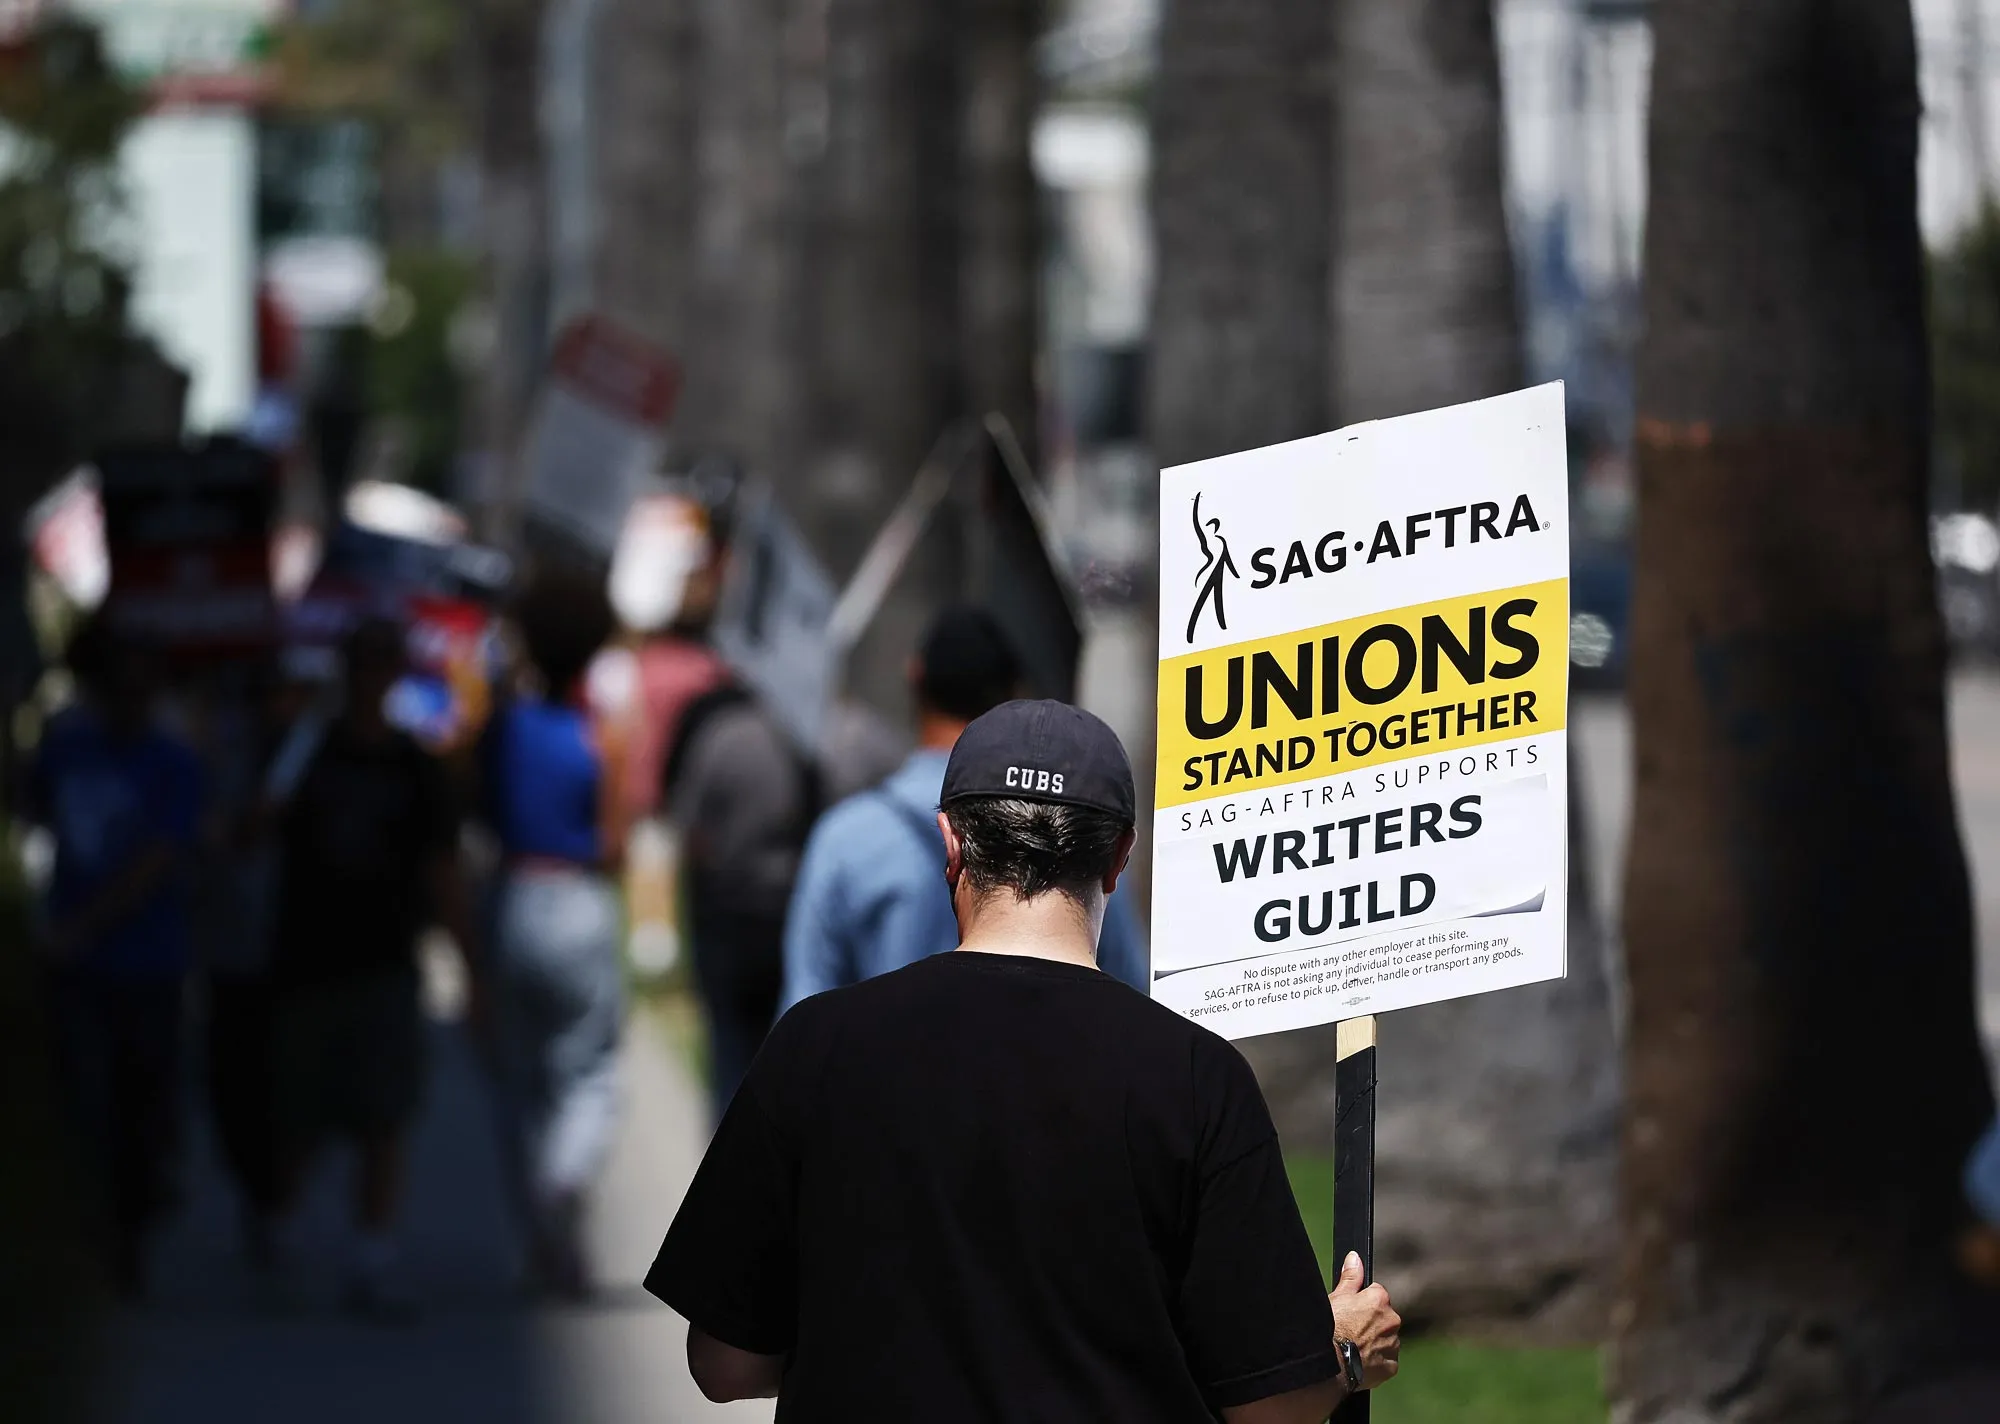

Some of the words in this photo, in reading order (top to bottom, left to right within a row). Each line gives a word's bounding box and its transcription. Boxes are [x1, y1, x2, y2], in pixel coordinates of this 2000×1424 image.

[1184, 598, 1540, 741] UNIONS
[1183, 735, 1316, 791] STAND
[1323, 690, 1539, 764] TOGETHER
[1005, 766, 1064, 794] CUBS
[1181, 780, 1355, 832] SAG-AFTRA
[1375, 744, 1538, 793] SUPPORTS
[1212, 794, 1483, 884] WRITERS
[1253, 872, 1437, 943] GUILD
[1189, 1003, 1230, 1018] services,
[1231, 1000, 1243, 1010] or
[1245, 996, 1255, 1008] to
[1257, 991, 1288, 1006] refuse
[1290, 988, 1301, 1000] to
[1303, 983, 1323, 999] pick
[1325, 983, 1340, 997] up,
[1377, 966, 1410, 982] handle
[1412, 966, 1422, 976] or
[1425, 956, 1470, 975] transport
[1472, 953, 1490, 968] any
[1492, 946, 1524, 964] goods.
[1204, 981, 1261, 1001] SAG-AFTRA
[1263, 980, 1271, 991] is
[1273, 976, 1291, 988] not
[1292, 970, 1324, 987] asking
[1325, 968, 1343, 983] any
[1345, 956, 1390, 977] individual
[1392, 956, 1403, 967] to
[1405, 950, 1432, 964] cease
[1434, 939, 1489, 960] performing
[1491, 936, 1509, 951] any
[1244, 969, 1258, 980] No
[1260, 962, 1297, 978] dispute
[1299, 957, 1321, 971] with
[1323, 955, 1340, 970] any
[1342, 949, 1368, 962] other
[1369, 940, 1414, 959] employer
[1415, 937, 1426, 947] at
[1428, 932, 1447, 945] this
[1448, 929, 1469, 941] site.
